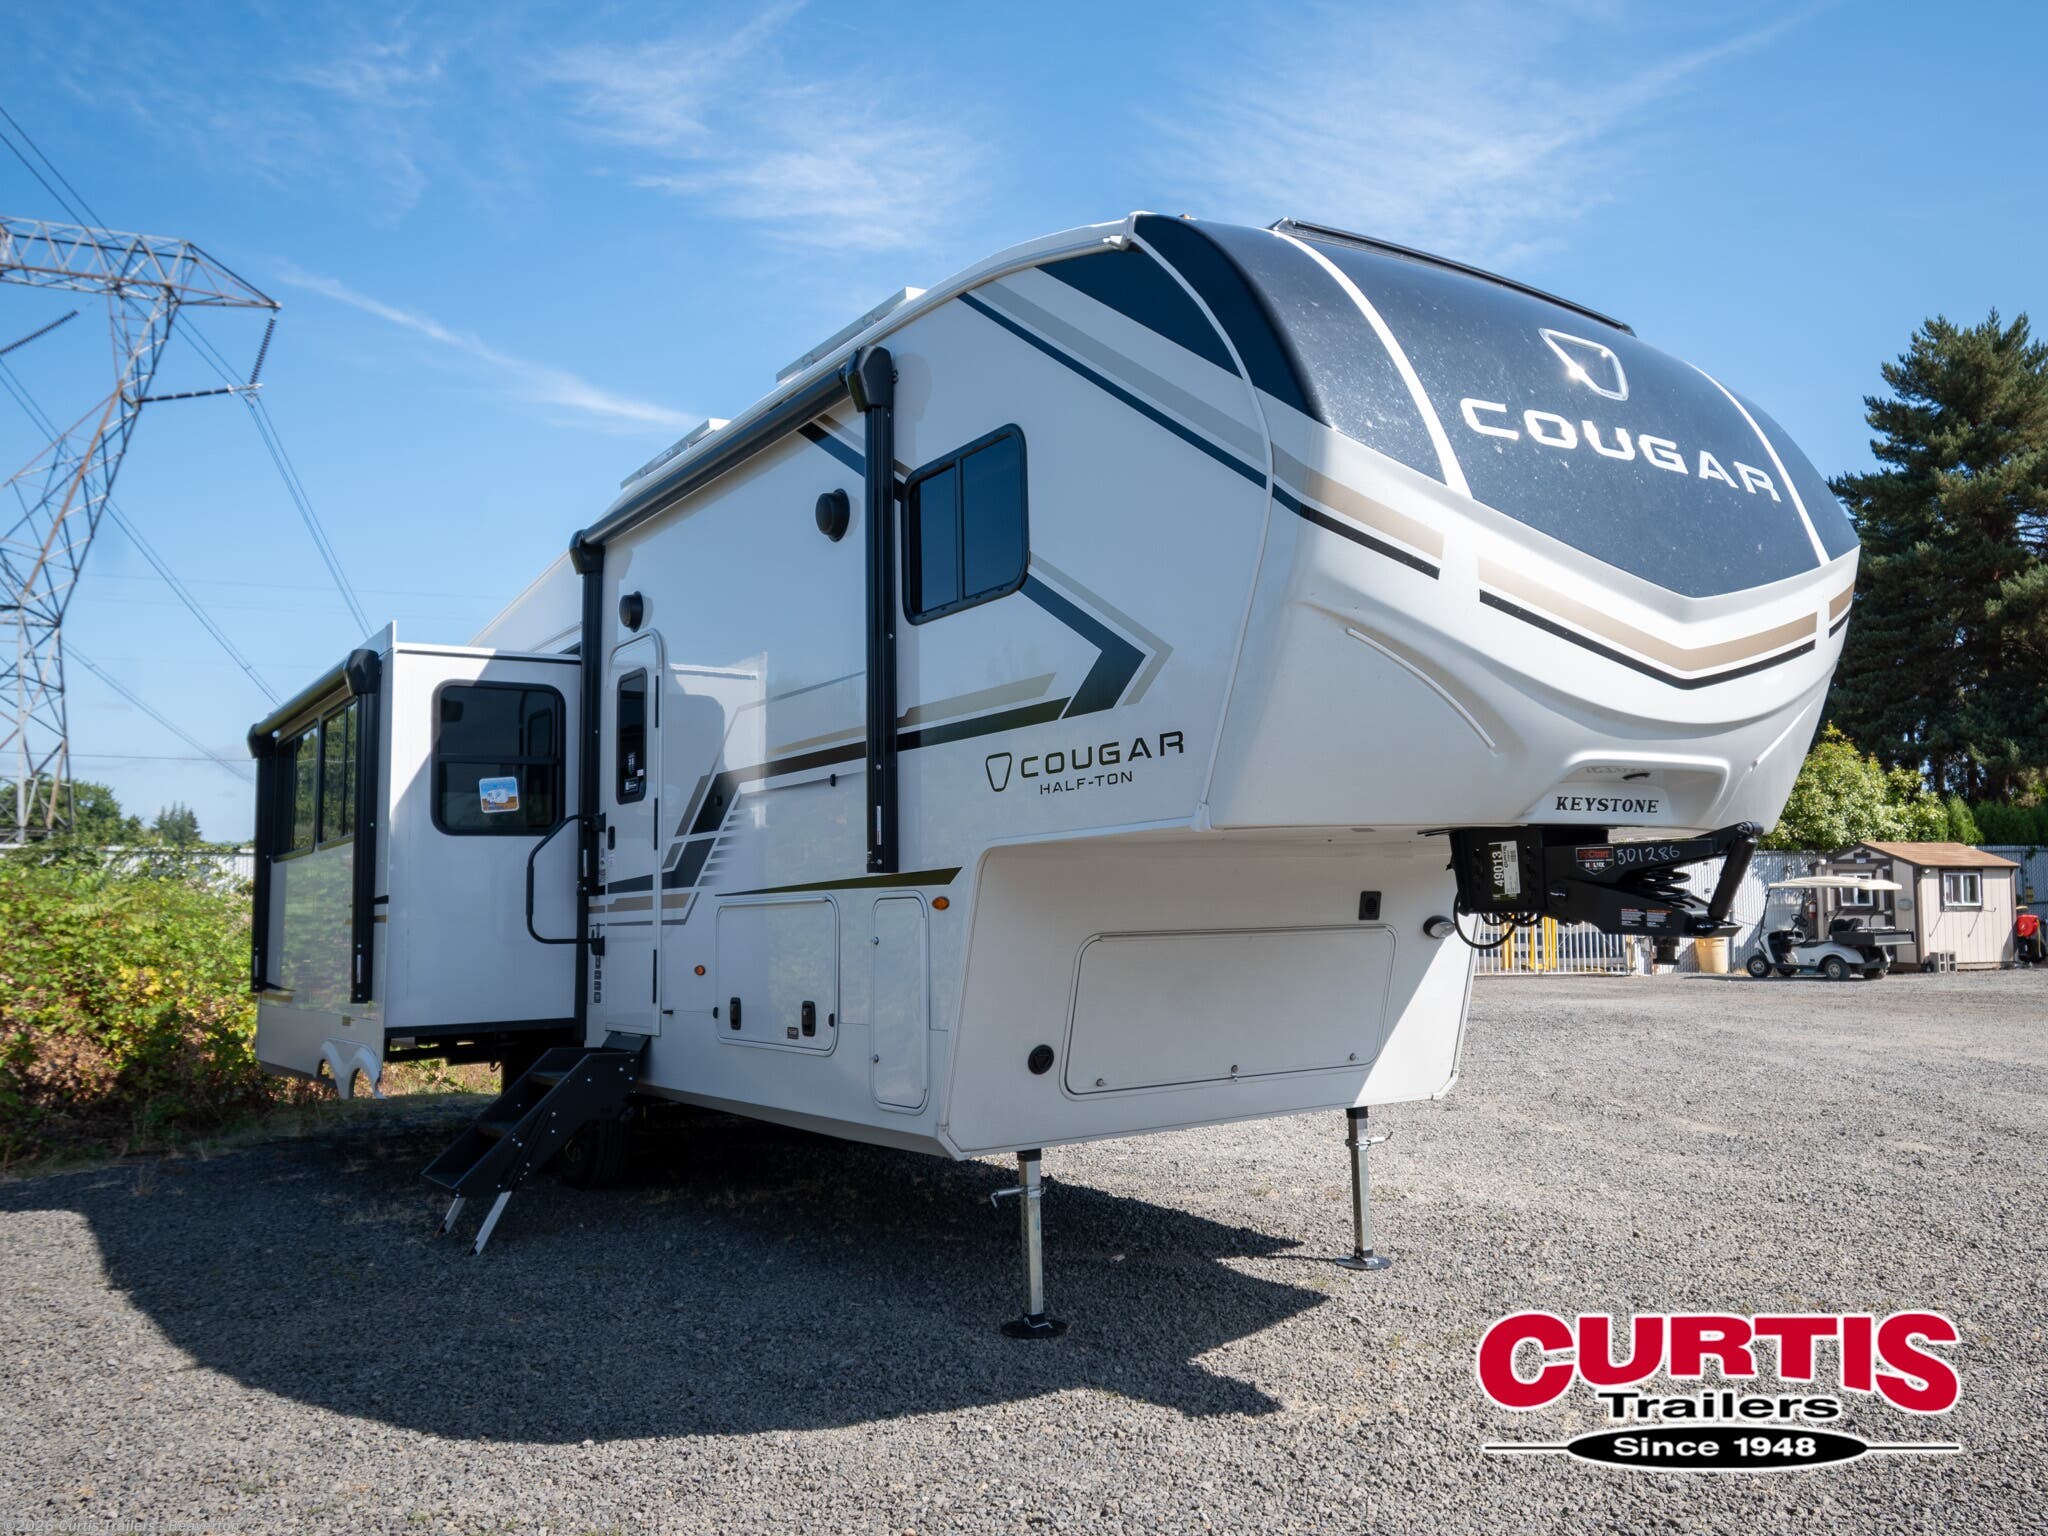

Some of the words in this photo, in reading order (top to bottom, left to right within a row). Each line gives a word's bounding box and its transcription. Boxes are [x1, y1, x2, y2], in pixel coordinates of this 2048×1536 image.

[1460, 397, 1782, 502] COUGAR
[1020, 730, 1185, 779] COUGAR
[1039, 770, 1134, 796] HALF-TON
[1555, 796, 1660, 814] KEYSTONE
[1491, 850, 1505, 887] 49013
[1616, 845, 1681, 866] 501286
